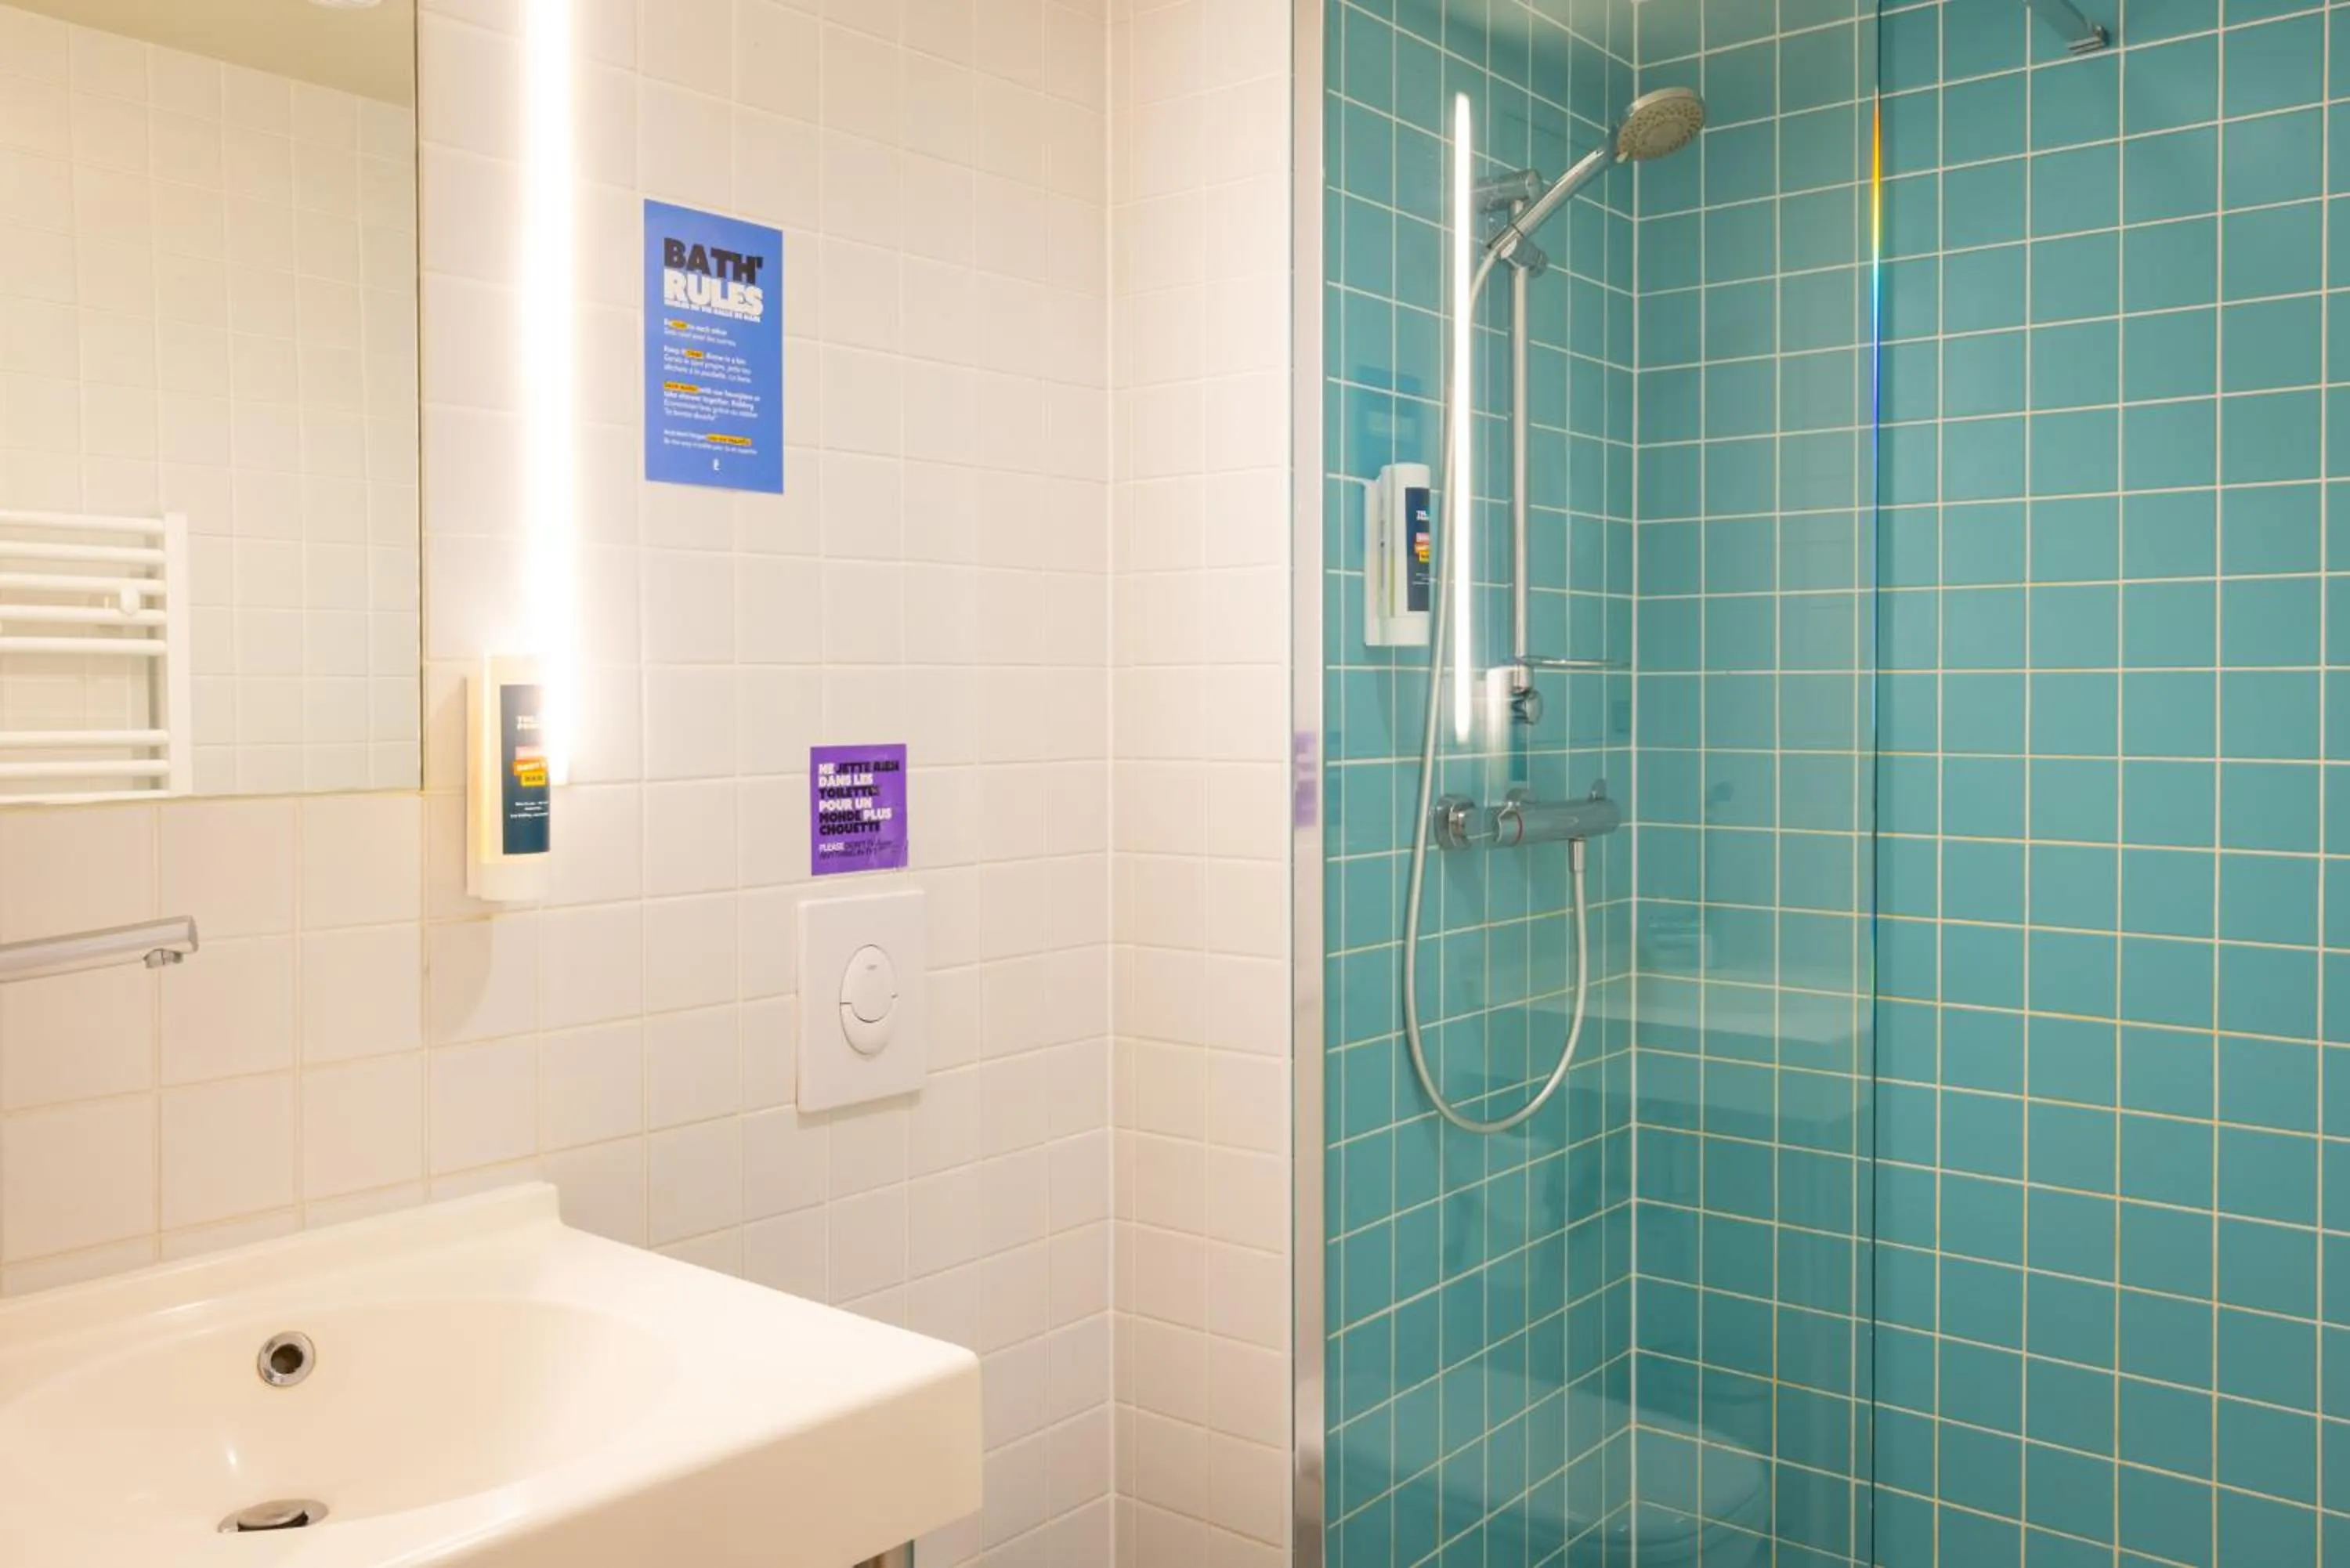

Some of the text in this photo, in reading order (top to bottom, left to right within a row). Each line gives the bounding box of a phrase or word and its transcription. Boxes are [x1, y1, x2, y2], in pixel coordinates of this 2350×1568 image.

[663, 269, 764, 316] RULES
[836, 762, 870, 774] JETTE
[819, 773, 873, 787] DANS LES
[819, 797, 873, 812] POUR UN
[819, 807, 892, 823] MONDE PLUS
